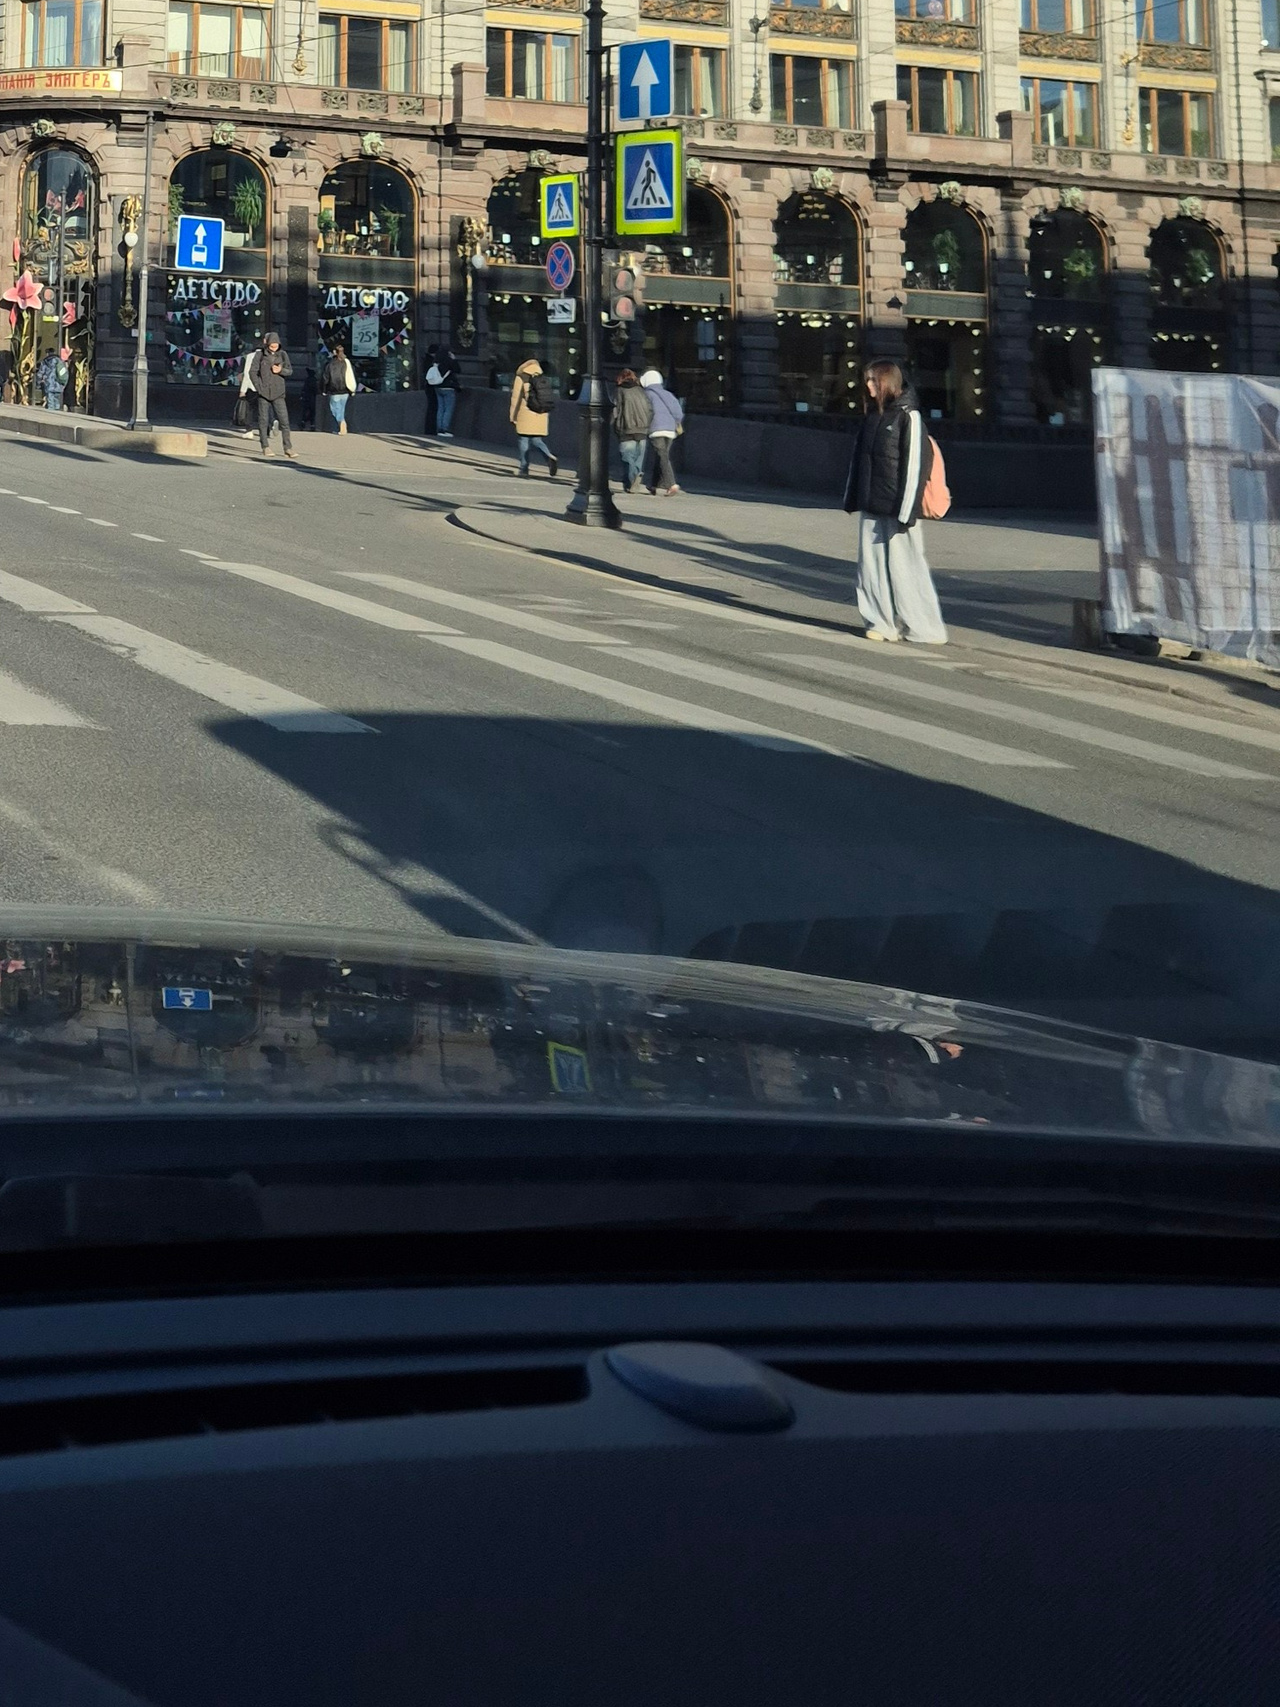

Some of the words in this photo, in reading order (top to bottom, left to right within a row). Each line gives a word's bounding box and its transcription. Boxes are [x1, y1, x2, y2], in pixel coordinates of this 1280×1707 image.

[45, 73, 111, 89] ЗИНГЕРЪ
[173, 278, 262, 302] ДЕТСТВО
[324, 287, 410, 310] ДЕТСТВО
